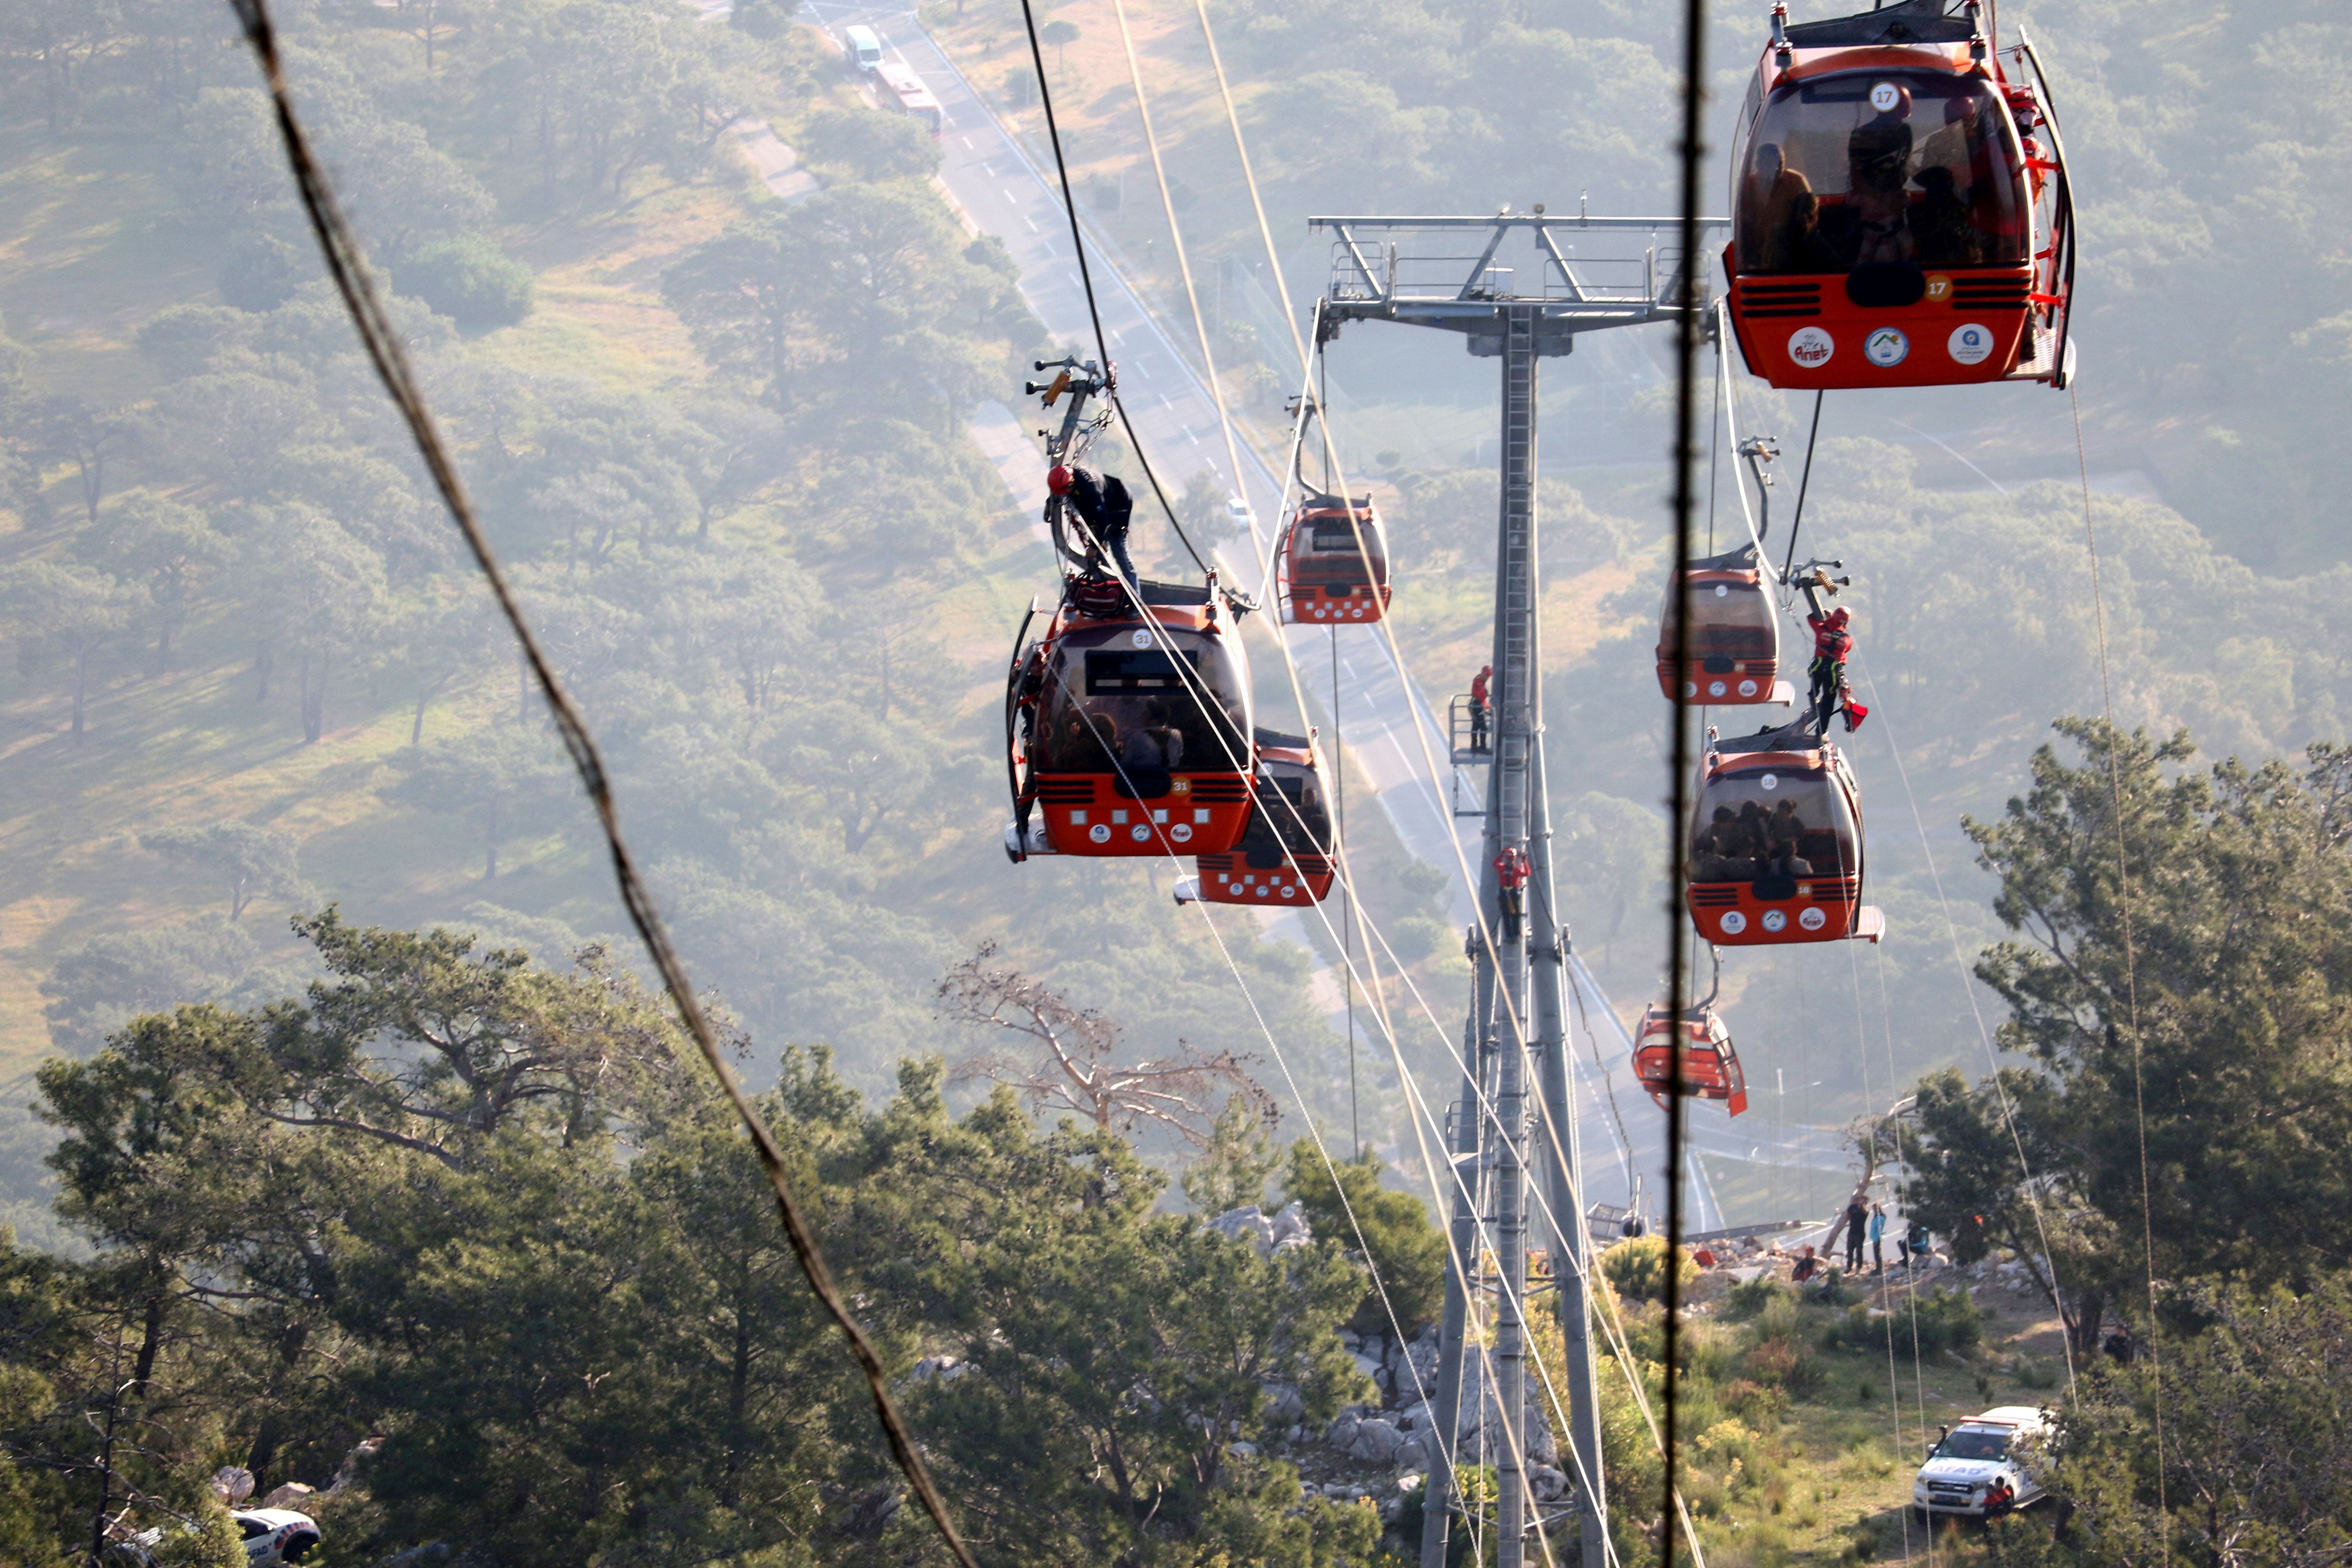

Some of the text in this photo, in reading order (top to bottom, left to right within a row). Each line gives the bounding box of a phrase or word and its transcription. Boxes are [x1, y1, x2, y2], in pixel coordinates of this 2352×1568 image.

[1876, 91, 1893, 103] 17
[1928, 282, 1947, 294] 17
[1795, 343, 1828, 361] Anet
[1136, 634, 1148, 644] 31
[1173, 782, 1187, 790] 31
[1929, 1466, 1981, 1475] AFAD
